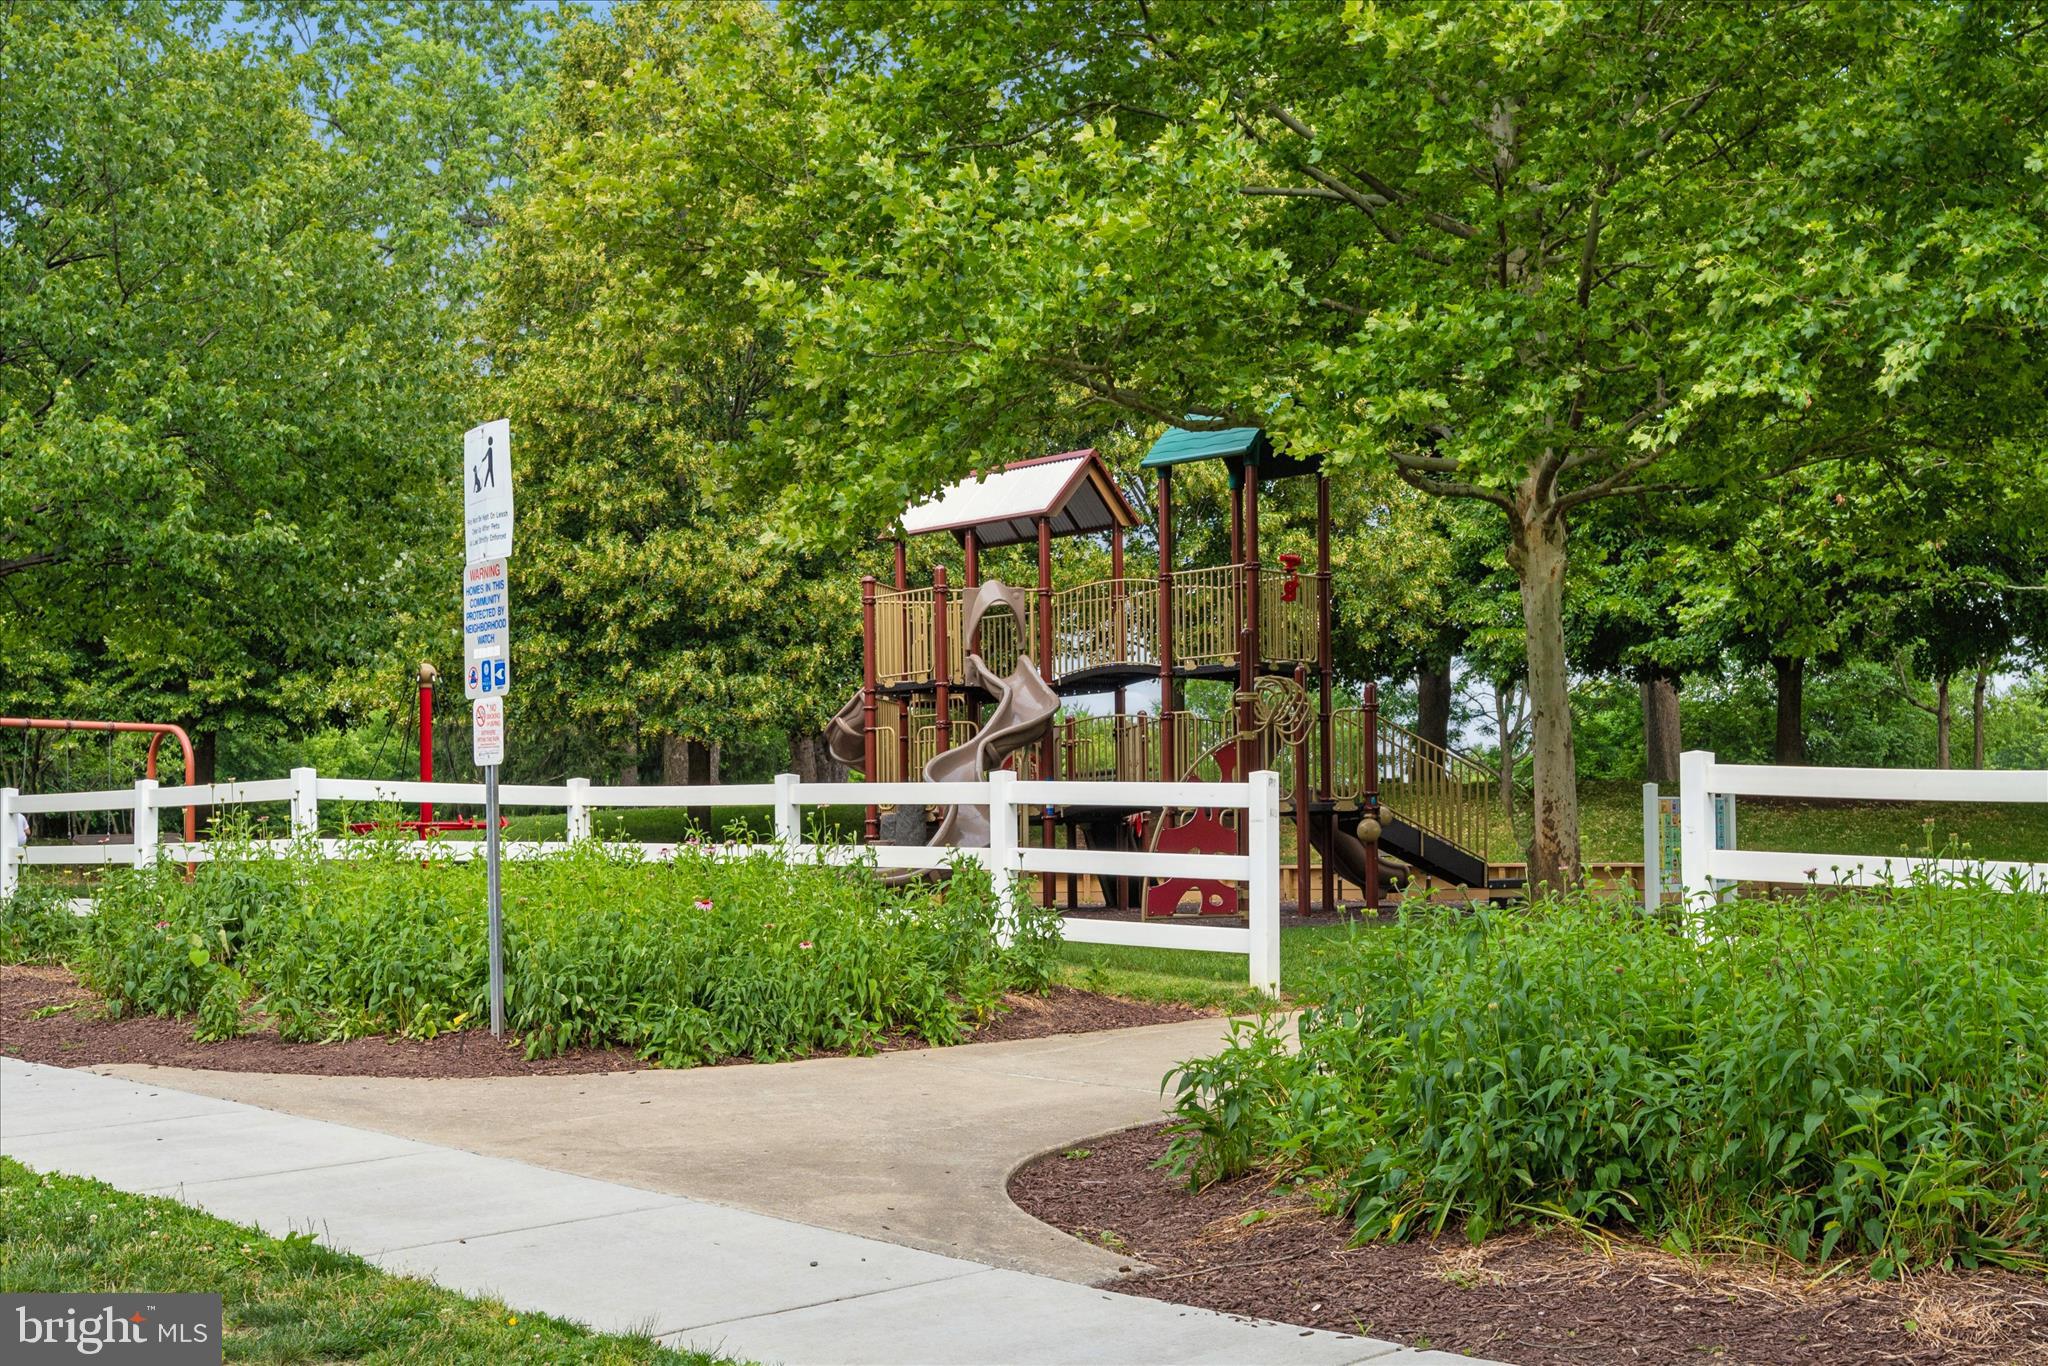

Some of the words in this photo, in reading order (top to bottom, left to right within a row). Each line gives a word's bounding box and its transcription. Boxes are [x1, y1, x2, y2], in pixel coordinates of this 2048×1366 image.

[469, 564, 501, 581] WARNING
[466, 584, 484, 596] HOMES
[485, 582, 491, 593] IN
[493, 579, 504, 590] THIS
[469, 593, 501, 608] COMMUNITY
[466, 607, 496, 621] PROTECTED
[497, 606, 504, 616] BY
[465, 618, 507, 633] NEIGHBORHOOD
[477, 634, 495, 645] WATCH
